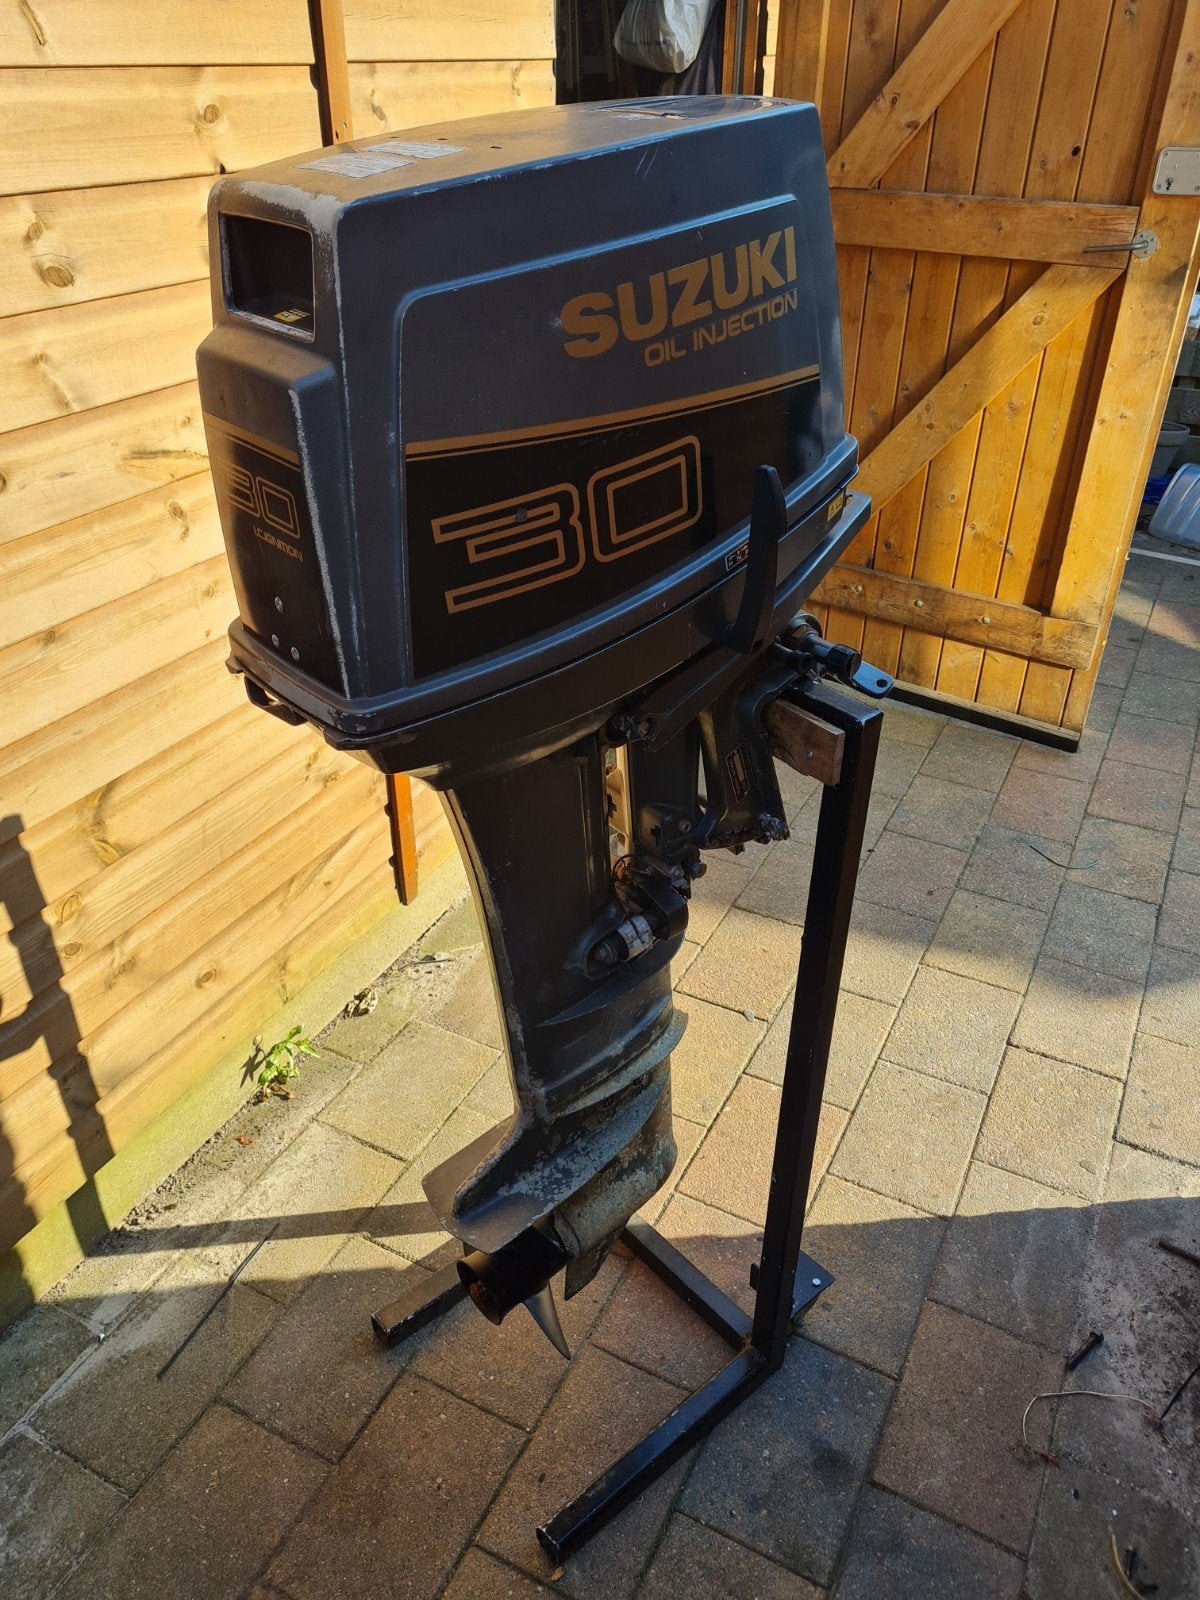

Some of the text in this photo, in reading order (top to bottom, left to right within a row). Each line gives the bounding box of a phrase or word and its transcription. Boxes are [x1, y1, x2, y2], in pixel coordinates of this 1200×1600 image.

[561, 225, 797, 359] SUZUKI
[643, 288, 798, 368] OIL INJECTION
[219, 457, 301, 540] 30
[430, 434, 703, 615] 30
